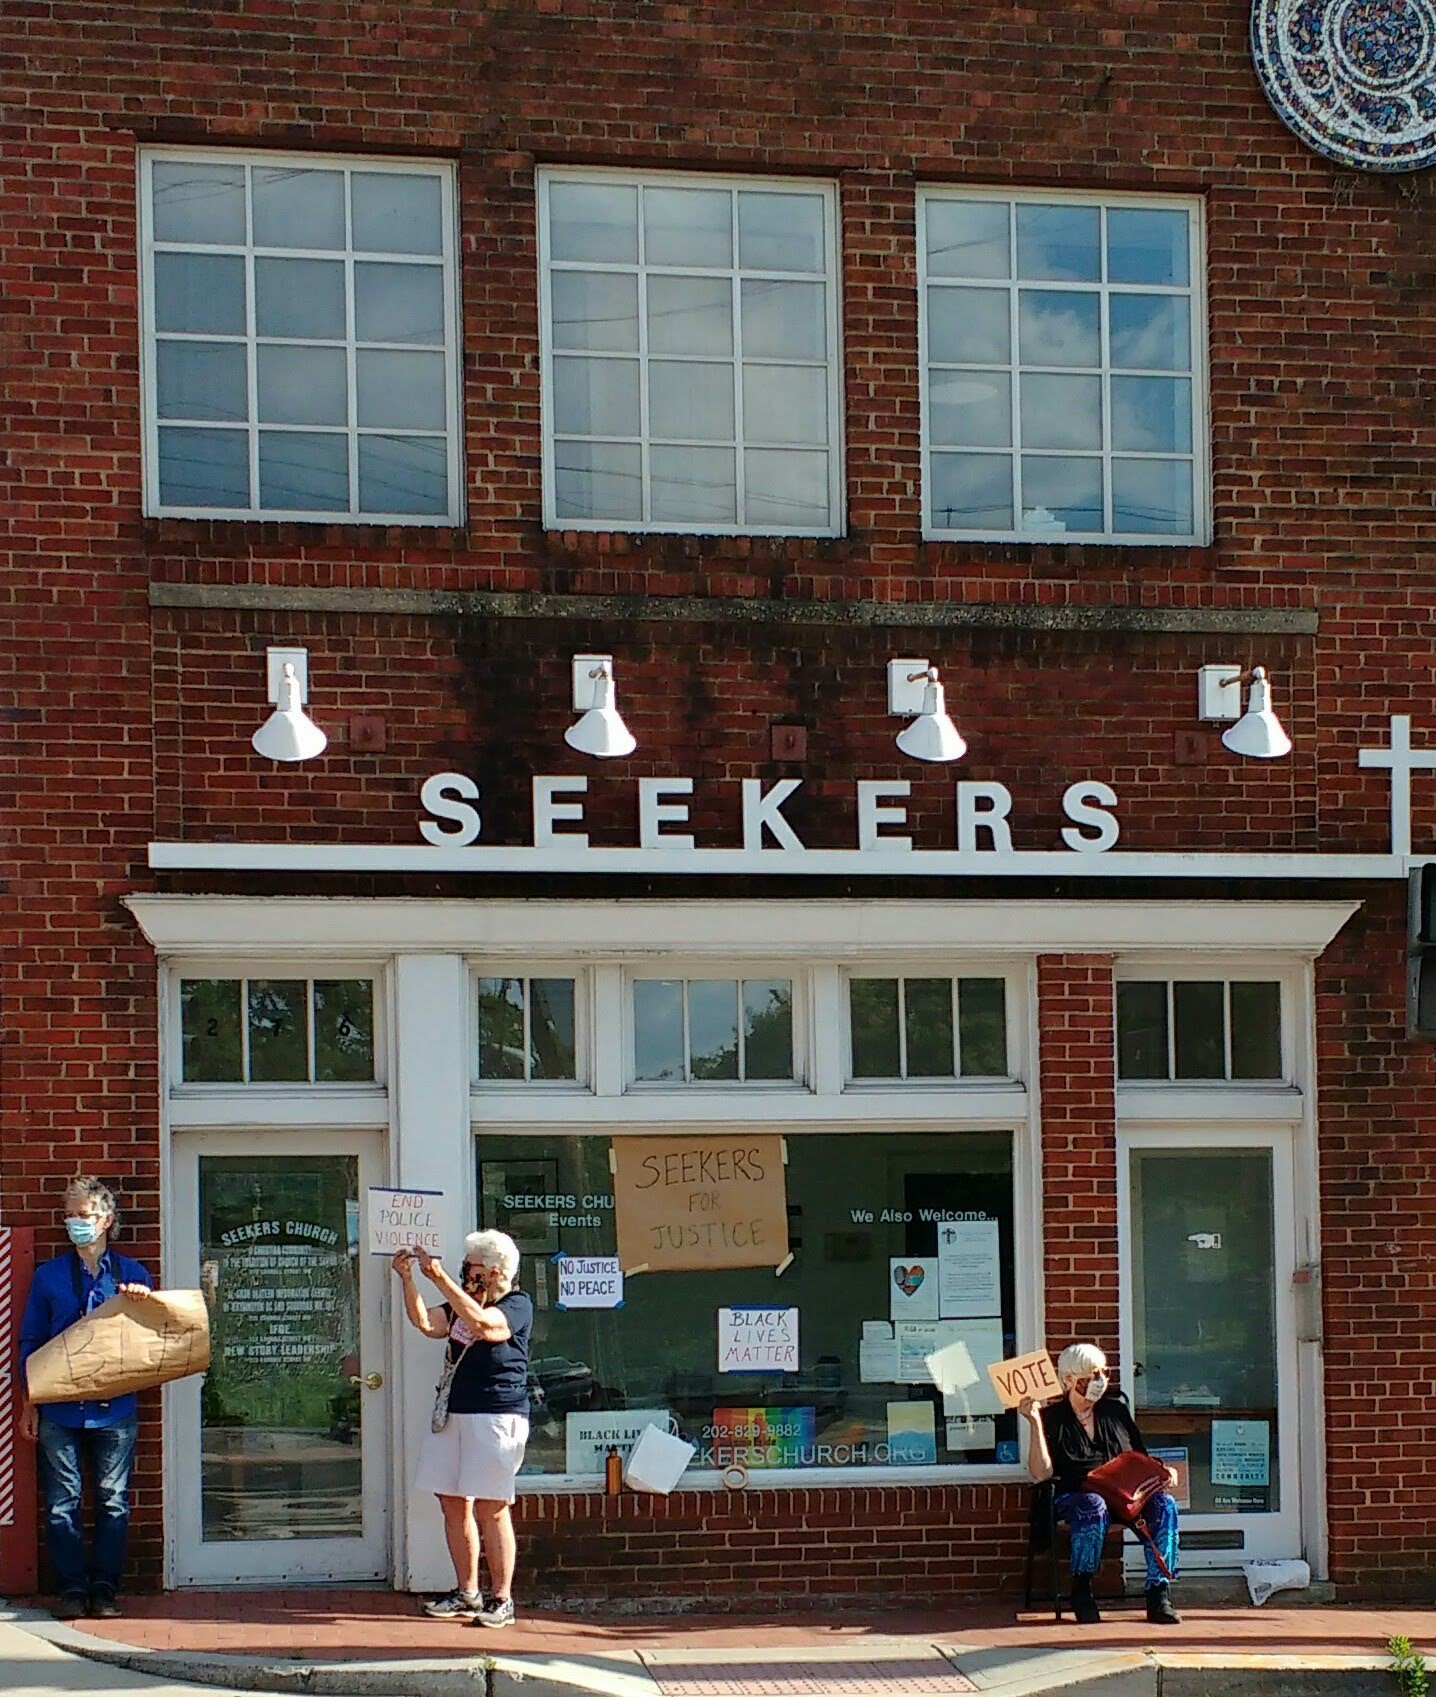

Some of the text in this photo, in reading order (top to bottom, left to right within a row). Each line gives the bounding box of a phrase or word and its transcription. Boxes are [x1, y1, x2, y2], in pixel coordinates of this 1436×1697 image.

[418, 772, 1121, 854] SEEKERS
[207, 1018, 219, 1036] 2
[339, 1016, 351, 1036] 6
[635, 1147, 766, 1190] SEEKERS
[391, 1194, 424, 1209] END
[503, 1194, 615, 1209] SEEKERS CHU
[688, 1191, 721, 1213] FOR
[379, 1210, 437, 1228] POLICE
[550, 1212, 602, 1227] Events
[851, 1209, 874, 1223] We
[880, 1208, 913, 1223] Also
[221, 1221, 340, 1247] SEEKERS CHURCH
[375, 1231, 440, 1248] VIOLENCE
[650, 1219, 766, 1250] JUSTICE
[560, 1260, 574, 1275] NO
[560, 1280, 616, 1296] NO PEACE
[729, 1312, 788, 1327] BLACK
[734, 1328, 791, 1344] LIVES
[224, 1345, 245, 1357] NEW
[725, 1345, 796, 1363] MATTER
[996, 1358, 1056, 1397] VOTE
[579, 1429, 620, 1440] BLACK
[702, 1424, 801, 1438] 202-829-9882
